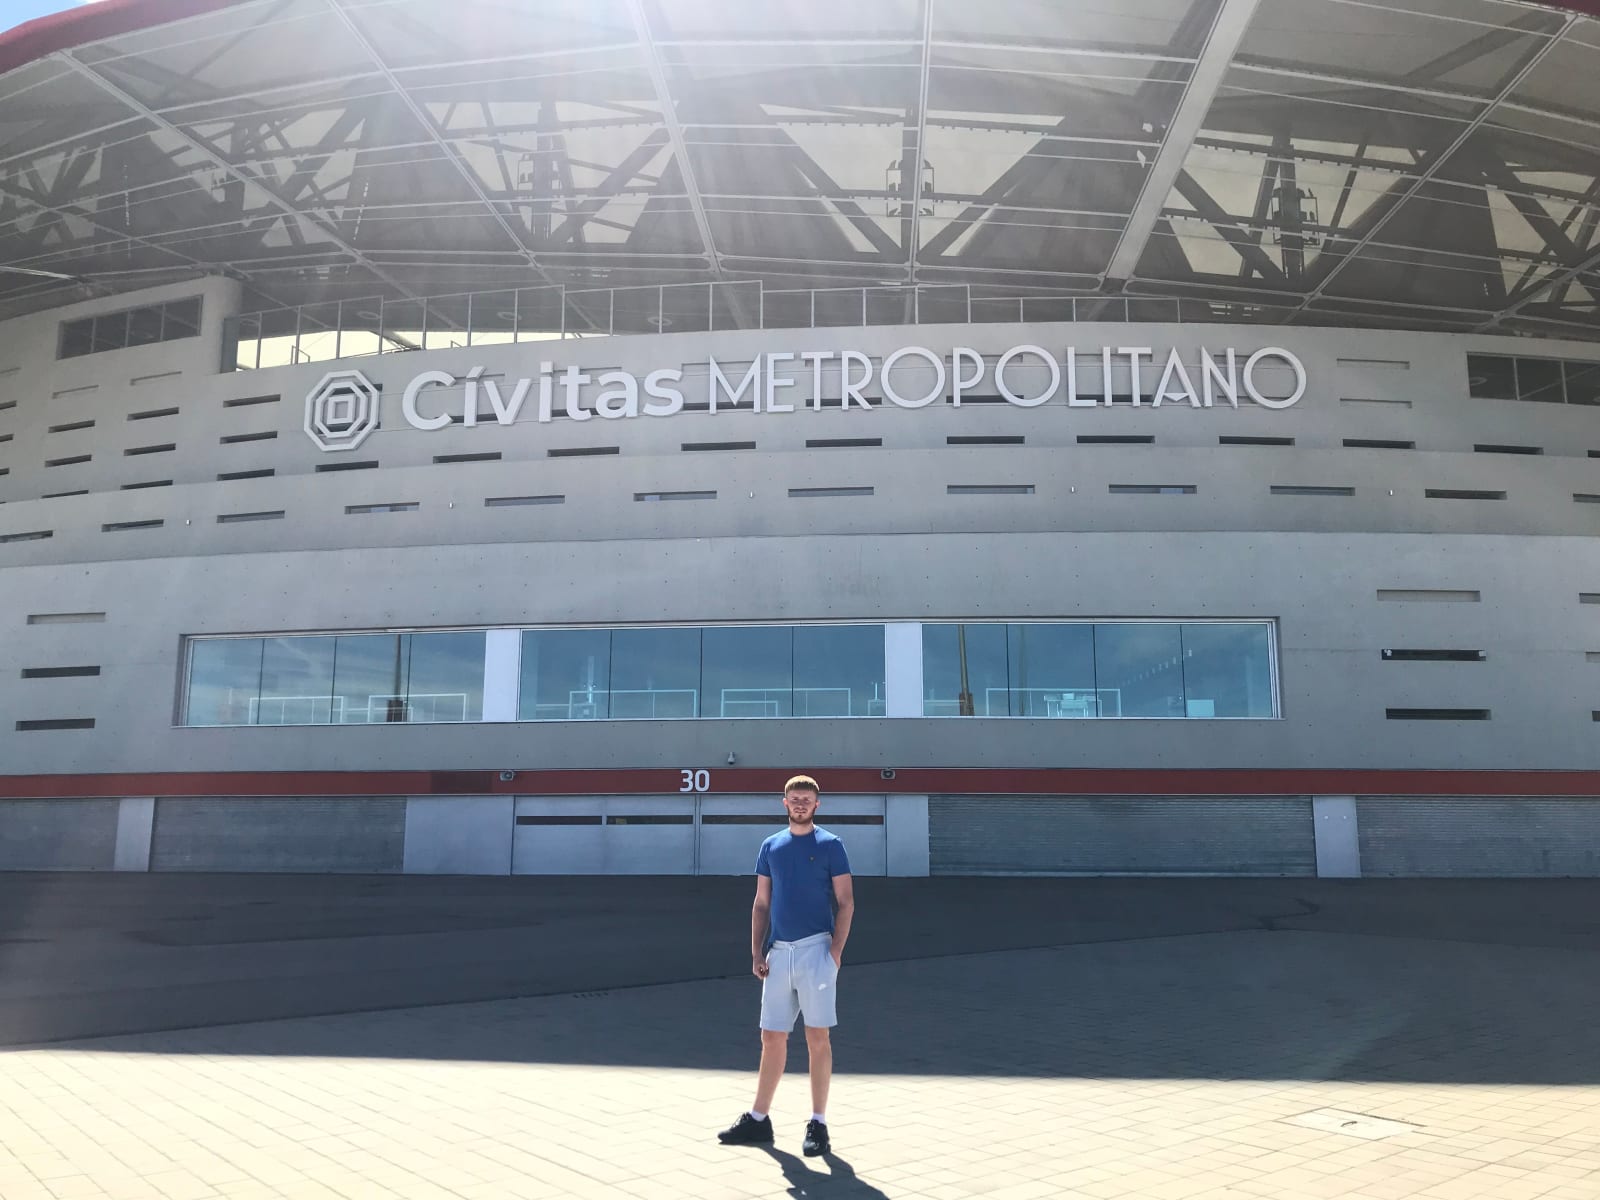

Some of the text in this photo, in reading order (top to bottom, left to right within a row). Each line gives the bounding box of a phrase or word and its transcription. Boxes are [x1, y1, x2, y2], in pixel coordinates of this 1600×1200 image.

[402, 345, 1307, 430] Cívitas METROPOLITANO
[680, 769, 710, 792] 30
